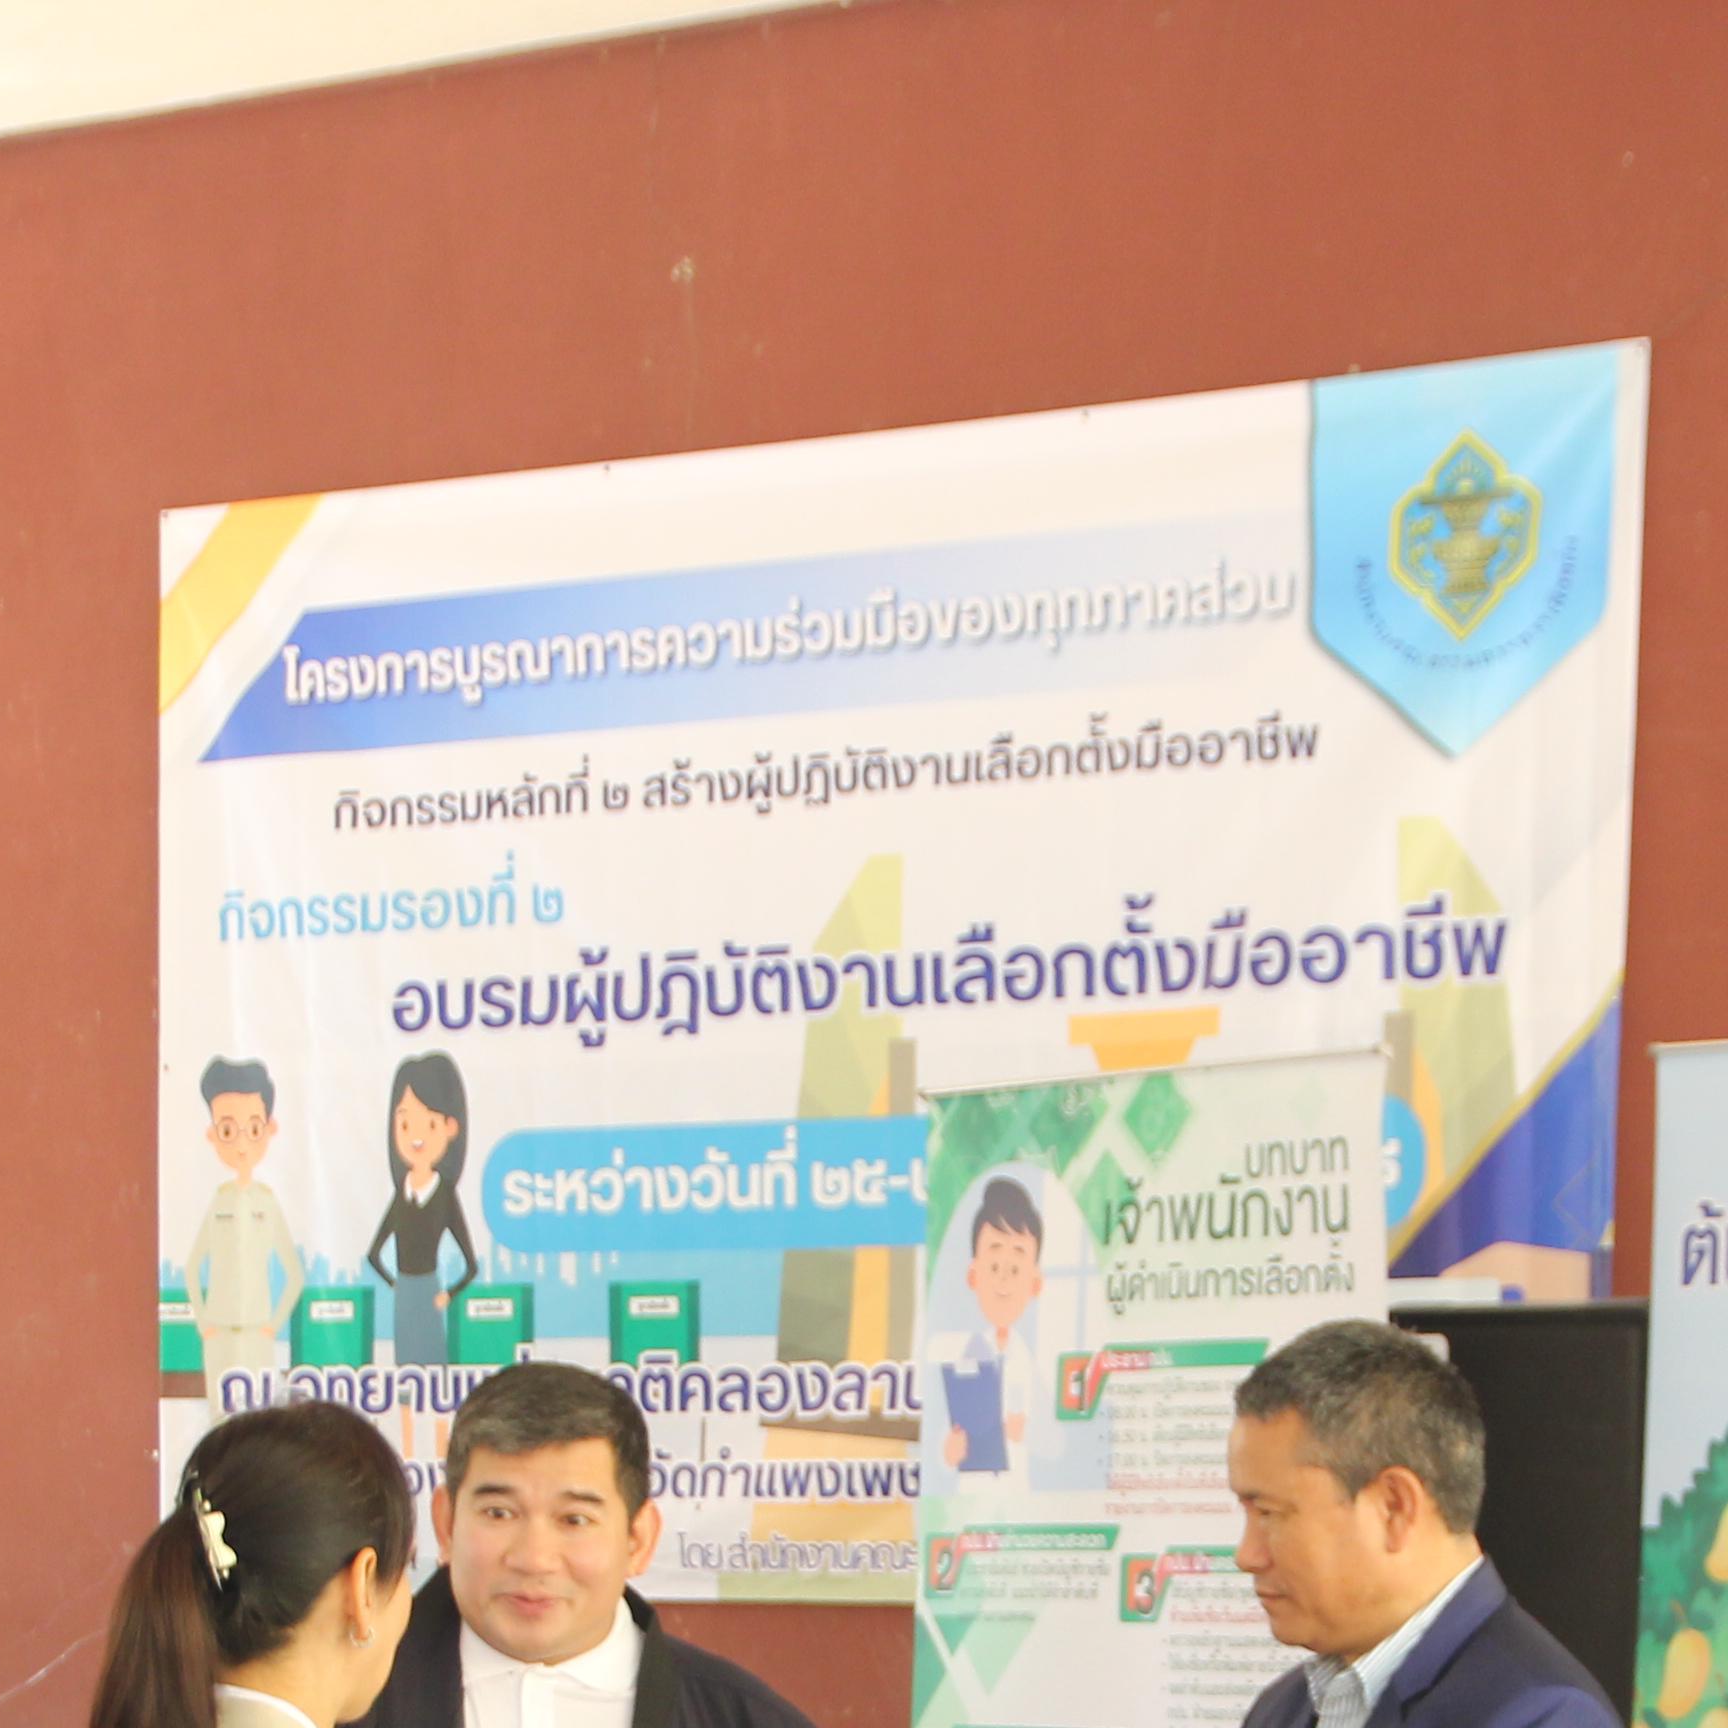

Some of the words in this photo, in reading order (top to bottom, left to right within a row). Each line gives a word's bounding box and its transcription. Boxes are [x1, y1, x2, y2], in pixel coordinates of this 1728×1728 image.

[333, 756, 589, 830] กิจกรรมหลักที่
[603, 779, 630, 810] ๒
[642, 711, 1319, 815] สร้างผู้ปฏิบัติงานเลือกตั้งมืออาชีพ
[219, 851, 516, 942] กิจกรรมรองที่
[531, 882, 566, 925] ๒
[392, 893, 1509, 1048] อบรมผู้ปฏิบัติงานเลือกตั้งมืออาชีพ
[503, 1125, 798, 1217] ระหว่างวันที่
[1245, 1135, 1350, 1178] บทบาท
[1103, 1173, 1350, 1246] เจ้าพนักงาน
